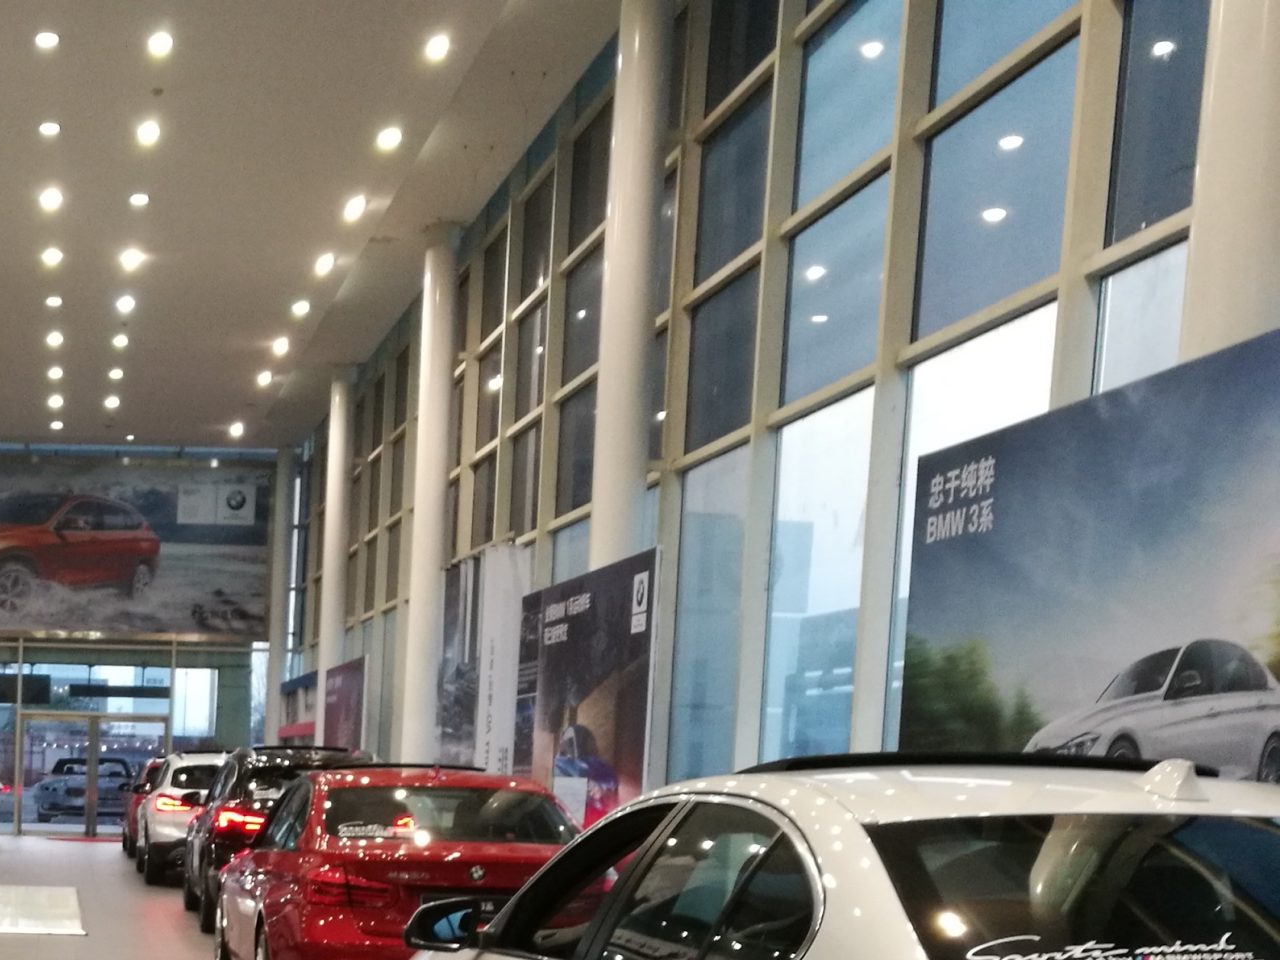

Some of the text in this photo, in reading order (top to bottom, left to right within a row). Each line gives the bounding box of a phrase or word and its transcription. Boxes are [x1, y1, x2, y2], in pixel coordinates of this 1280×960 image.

[928, 455, 996, 510] 忠于纯粹
[925, 498, 994, 544] BMW 3系
